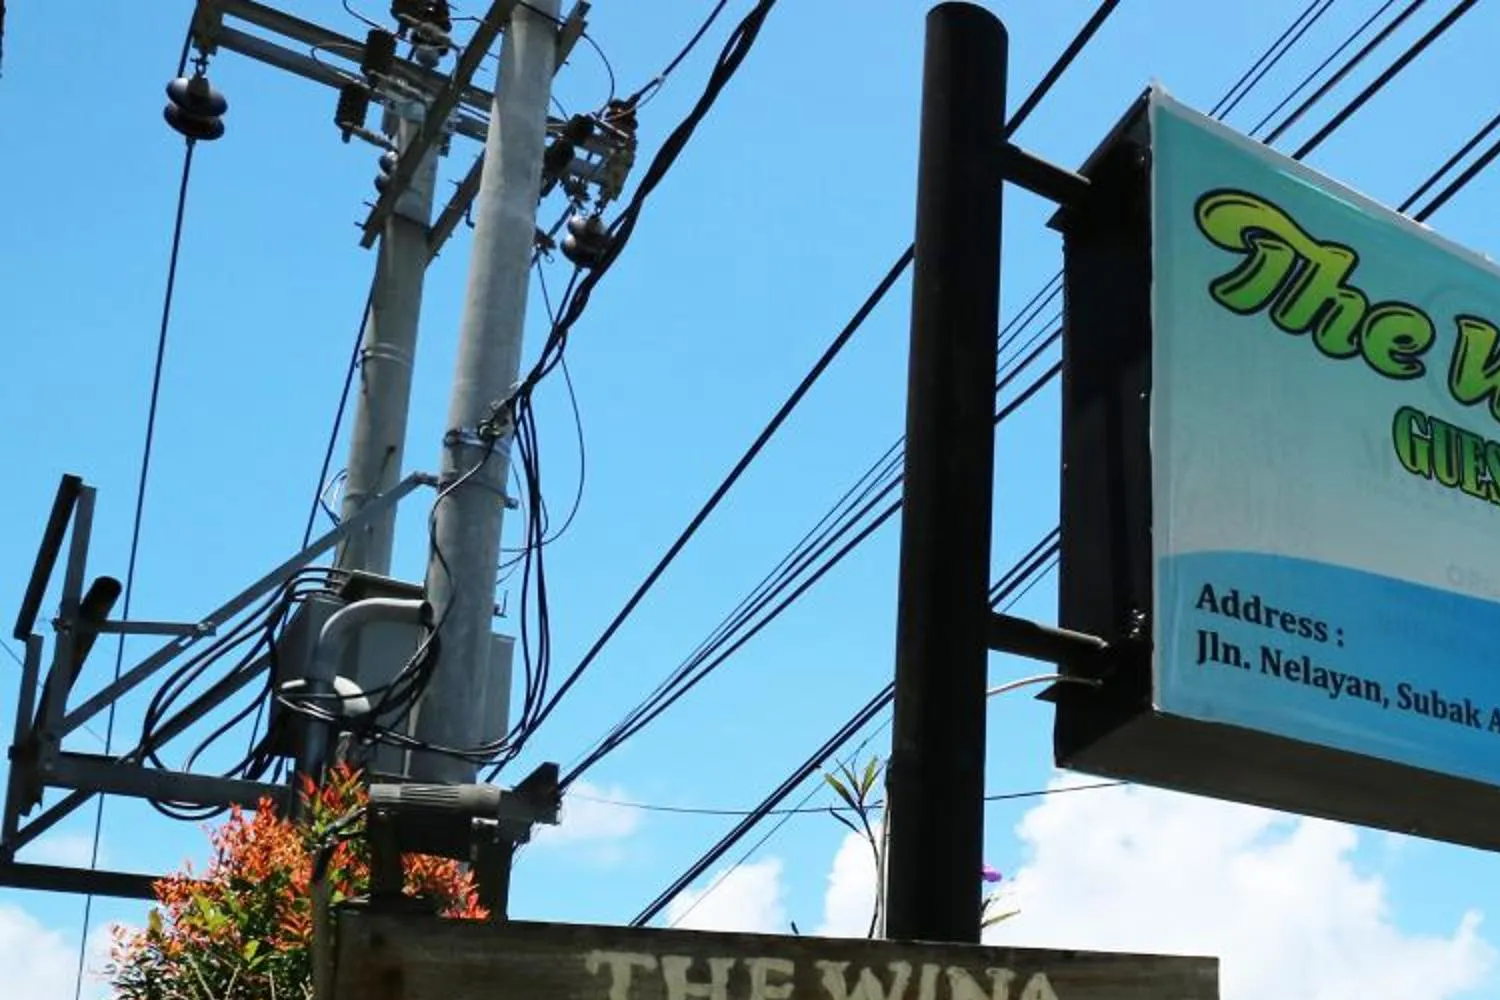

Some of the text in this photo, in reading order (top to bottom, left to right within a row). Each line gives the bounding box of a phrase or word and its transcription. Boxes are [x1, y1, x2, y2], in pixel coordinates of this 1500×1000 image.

[1194, 189, 1435, 379] The
[1196, 630, 1251, 670] Jln.
[1260, 650, 1390, 709] Nelayan,
[1397, 682, 1481, 730] Subak
